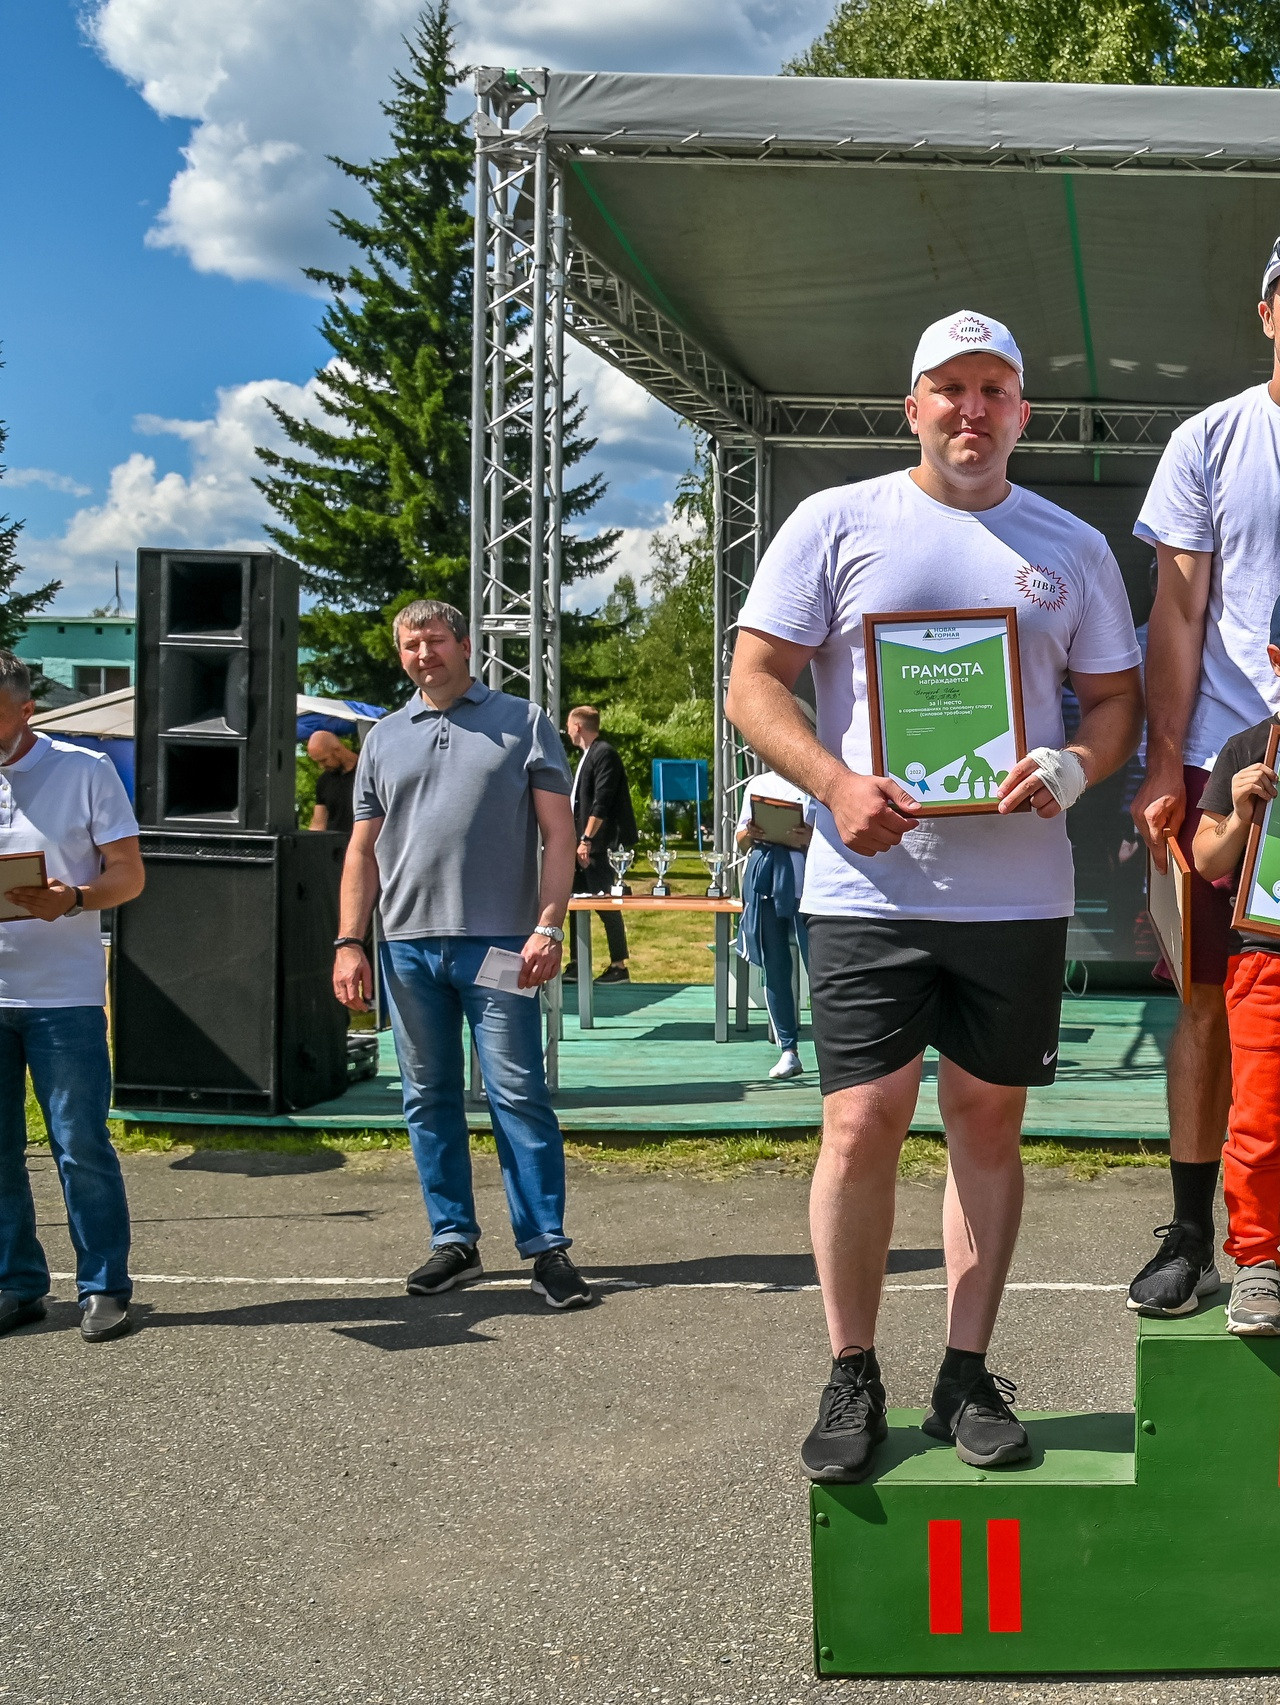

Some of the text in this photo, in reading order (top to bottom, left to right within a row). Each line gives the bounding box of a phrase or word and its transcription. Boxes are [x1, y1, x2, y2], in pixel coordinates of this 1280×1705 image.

[1032, 579, 1056, 594] ПВВ
[901, 662, 984, 679] ГРАМОТА
[919, 677, 969, 686] награждается
[927, 1518, 1022, 1634] II
